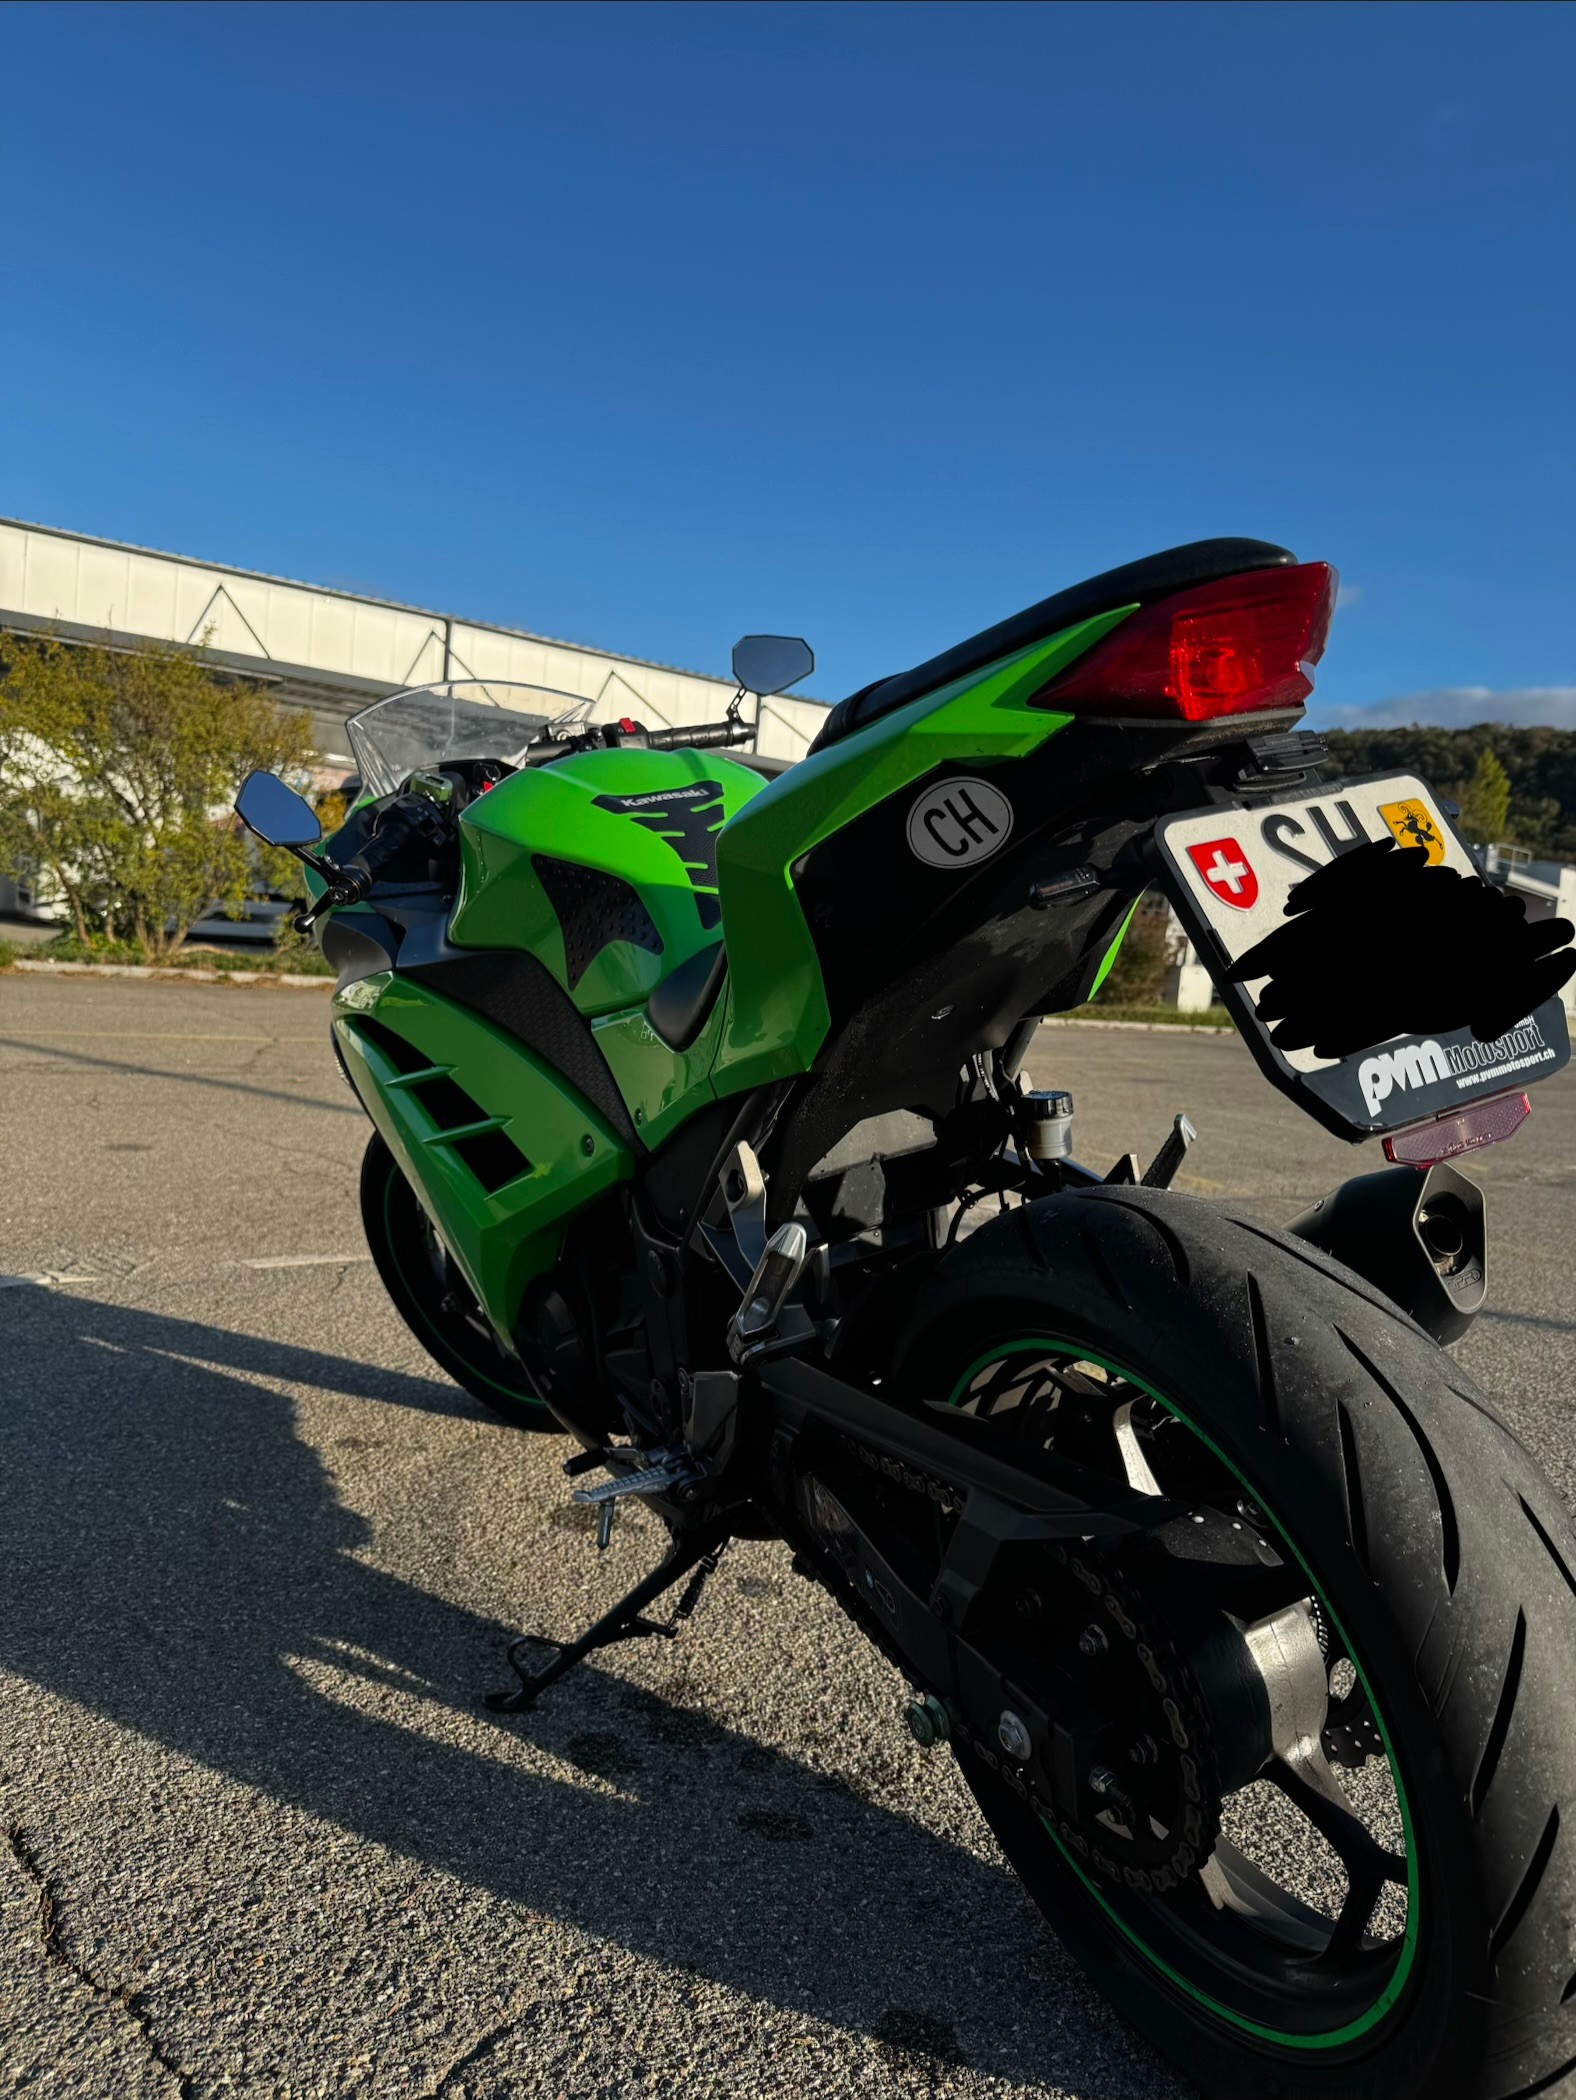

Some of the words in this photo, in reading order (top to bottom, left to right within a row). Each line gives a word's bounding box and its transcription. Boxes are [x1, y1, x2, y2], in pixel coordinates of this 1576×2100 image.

[621, 788, 709, 806] Kawasaki
[924, 788, 999, 856] CH
[1358, 1040, 1451, 1117] pvm
[1445, 1025, 1545, 1076] Motosport
[1456, 1048, 1556, 1089] www.pvmmotosport.ch
